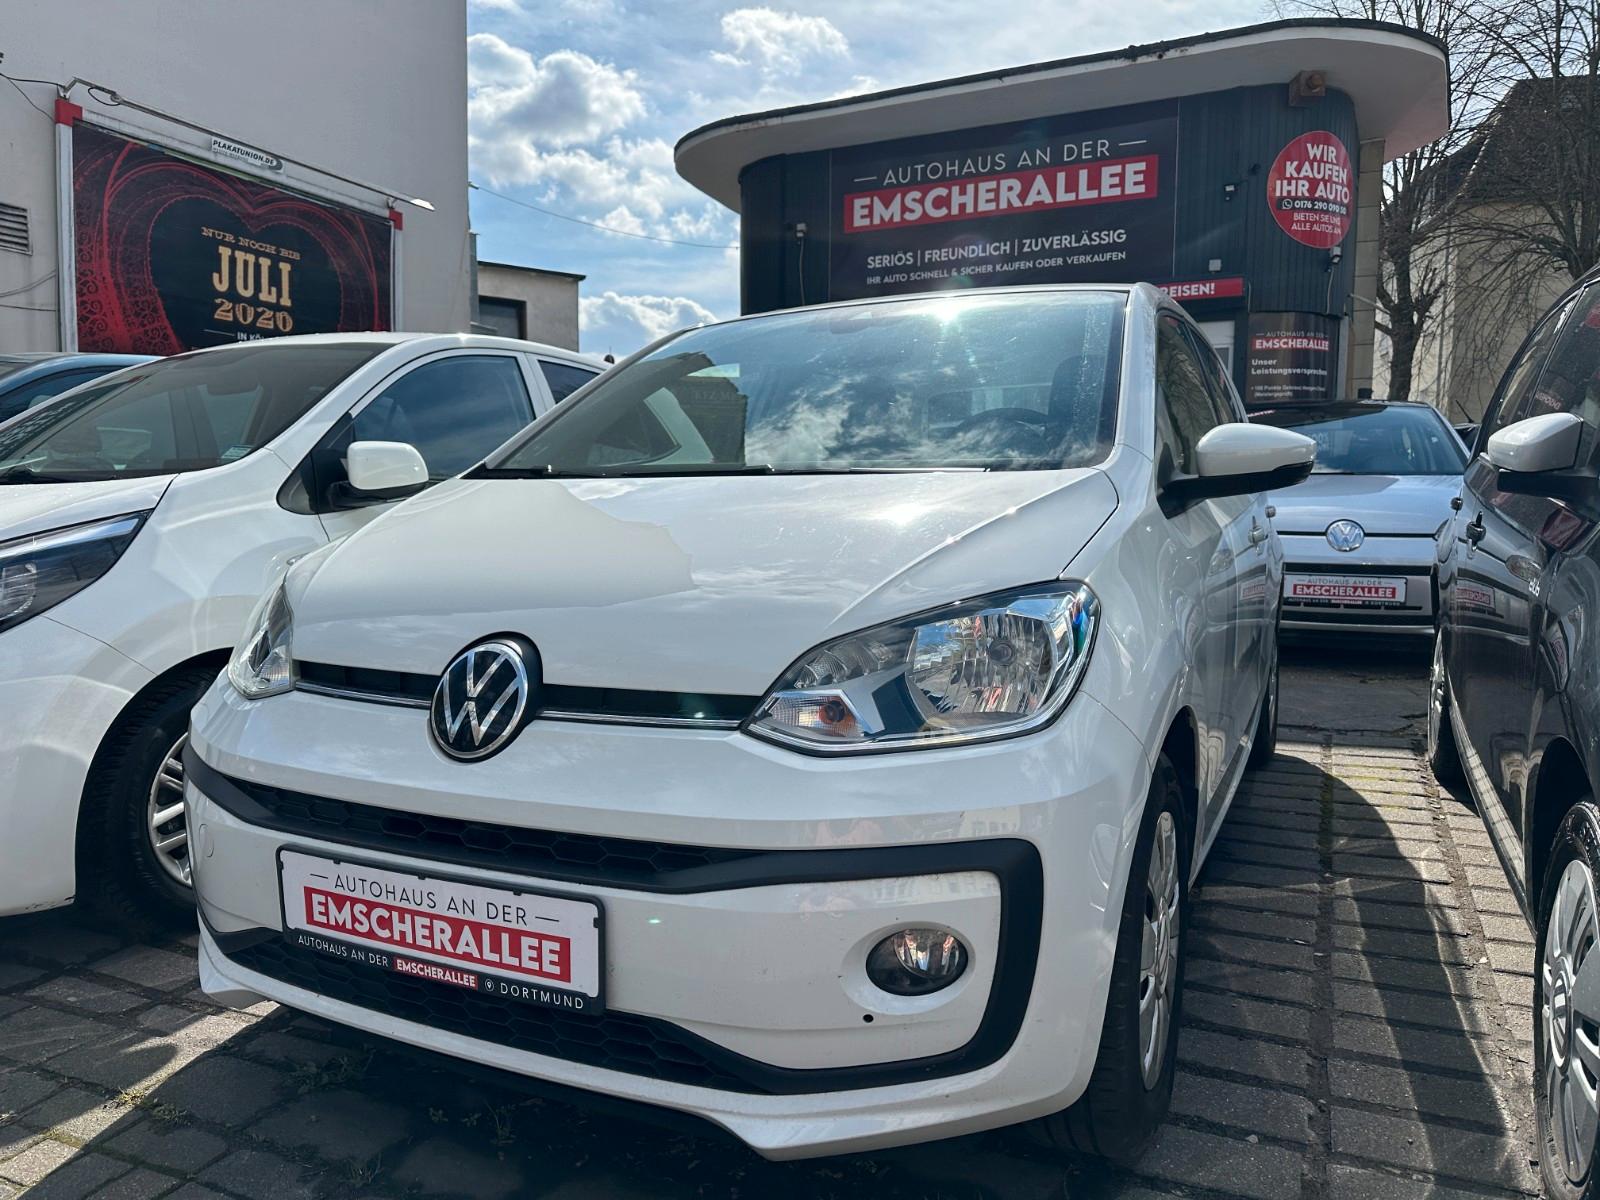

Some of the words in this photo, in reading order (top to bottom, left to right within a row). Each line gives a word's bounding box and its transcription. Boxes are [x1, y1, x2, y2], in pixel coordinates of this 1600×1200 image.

[213, 139, 275, 165] PLAKATUNION.DE
[884, 153, 1006, 186] AUTOHAUS
[1018, 147, 1050, 168] AN
[1064, 139, 1110, 162] DER
[1306, 143, 1337, 163] WIR
[1285, 161, 1347, 184] KAUFEN
[853, 162, 1146, 228] EMSCHERALLEE
[1275, 179, 1310, 197] IHR
[1314, 181, 1350, 204] AUTO
[1294, 200, 1312, 210] 0176
[1291, 222, 1311, 232] ALLE
[1293, 212, 1319, 222] BIETEN
[201, 227, 236, 243] NUR
[239, 237, 278, 254] NOCH
[867, 251, 914, 269] SERIÖS
[925, 241, 1010, 263] FREUNDLICH
[1022, 229, 1127, 252] ZUVERLÄSSIG
[212, 245, 292, 307] JULI
[867, 276, 881, 285] IHR
[883, 273, 908, 284] AUTO
[910, 269, 949, 281] SCHNELL
[960, 264, 993, 276] SICHER
[996, 260, 1033, 273] KAUFEN
[1036, 257, 1064, 268] ODER
[1066, 251, 1126, 265] VERKAUFEN
[214, 298, 293, 332] 2020
[1256, 339, 1329, 350] EMSCHERALLEE
[1296, 586, 1392, 598] EMSCHERALLEE
[334, 873, 437, 909] AUTOHAUS
[446, 896, 475, 916] AN
[486, 902, 528, 926] DER
[312, 892, 560, 975] EMSCHERALLEE
[298, 935, 348, 958] AUTOHAUS
[351, 949, 365, 961] AN
[369, 953, 389, 967] DER
[396, 959, 476, 988] EMSCHERALLEE
[500, 982, 584, 1010] DORTMUND
